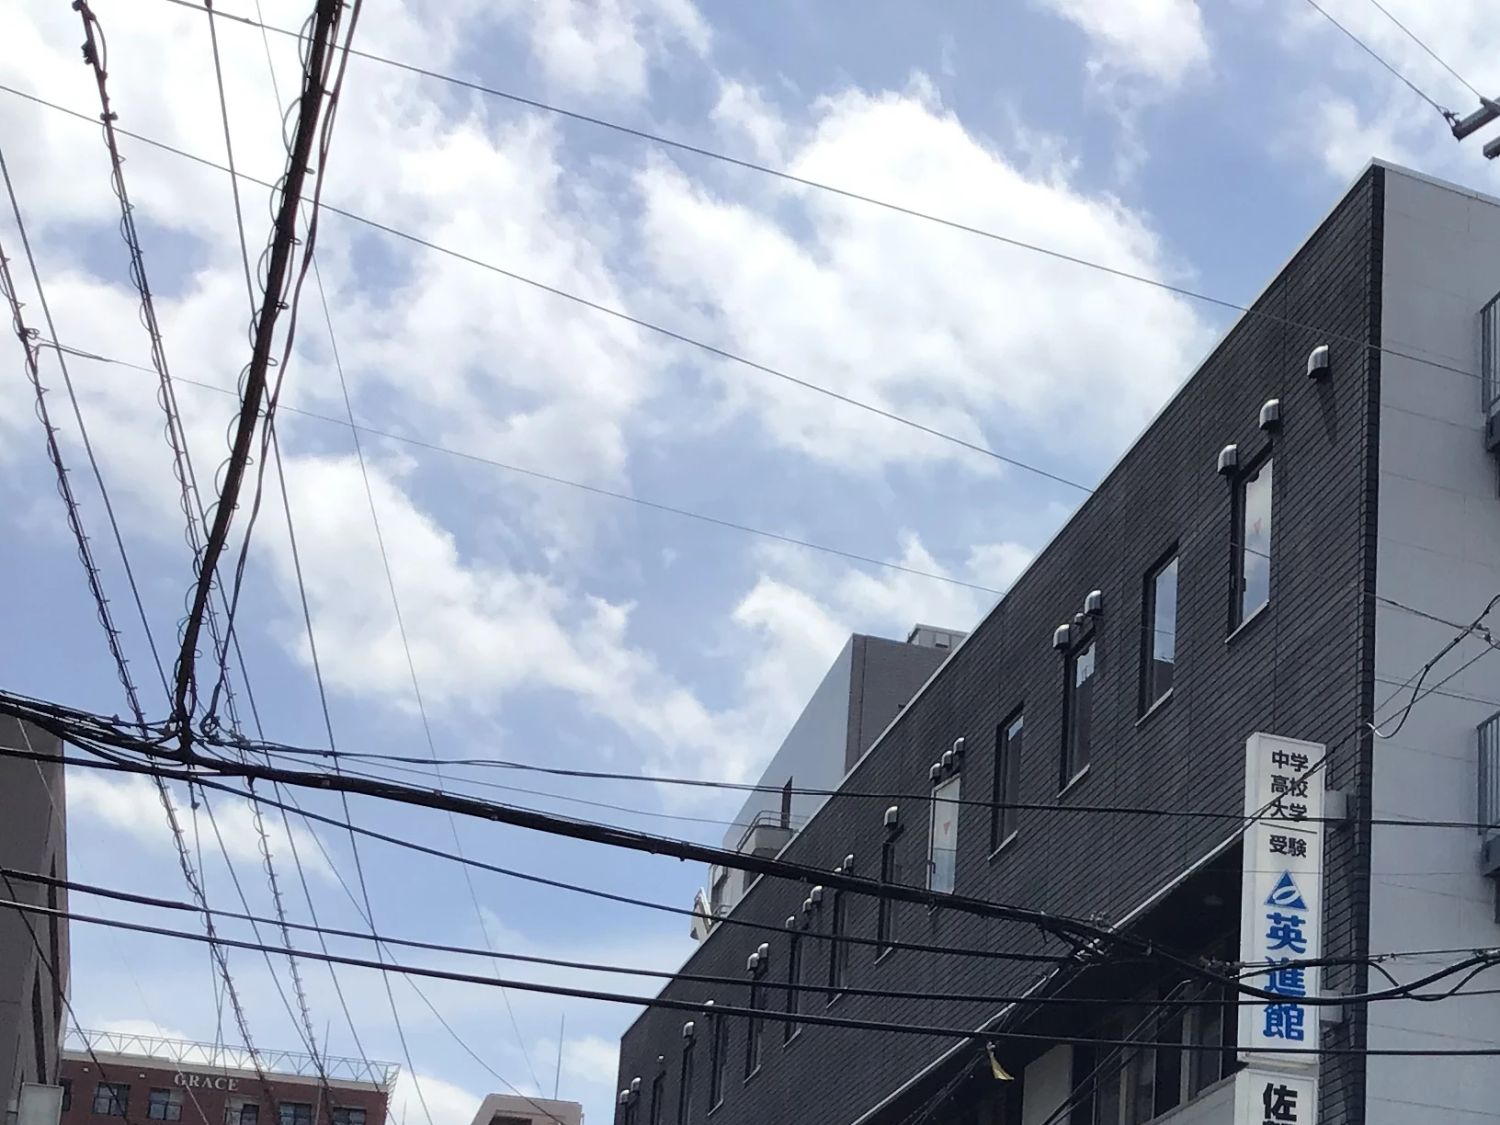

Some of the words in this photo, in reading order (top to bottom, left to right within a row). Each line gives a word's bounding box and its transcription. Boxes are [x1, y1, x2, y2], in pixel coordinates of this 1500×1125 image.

[1271, 750, 1308, 772] 中学
[1270, 774, 1308, 798] 高校
[1270, 800, 1308, 822] 大学
[1269, 835, 1307, 858] 受験
[1263, 912, 1308, 1041] 英進館
[174, 1073, 239, 1091] GRACE
